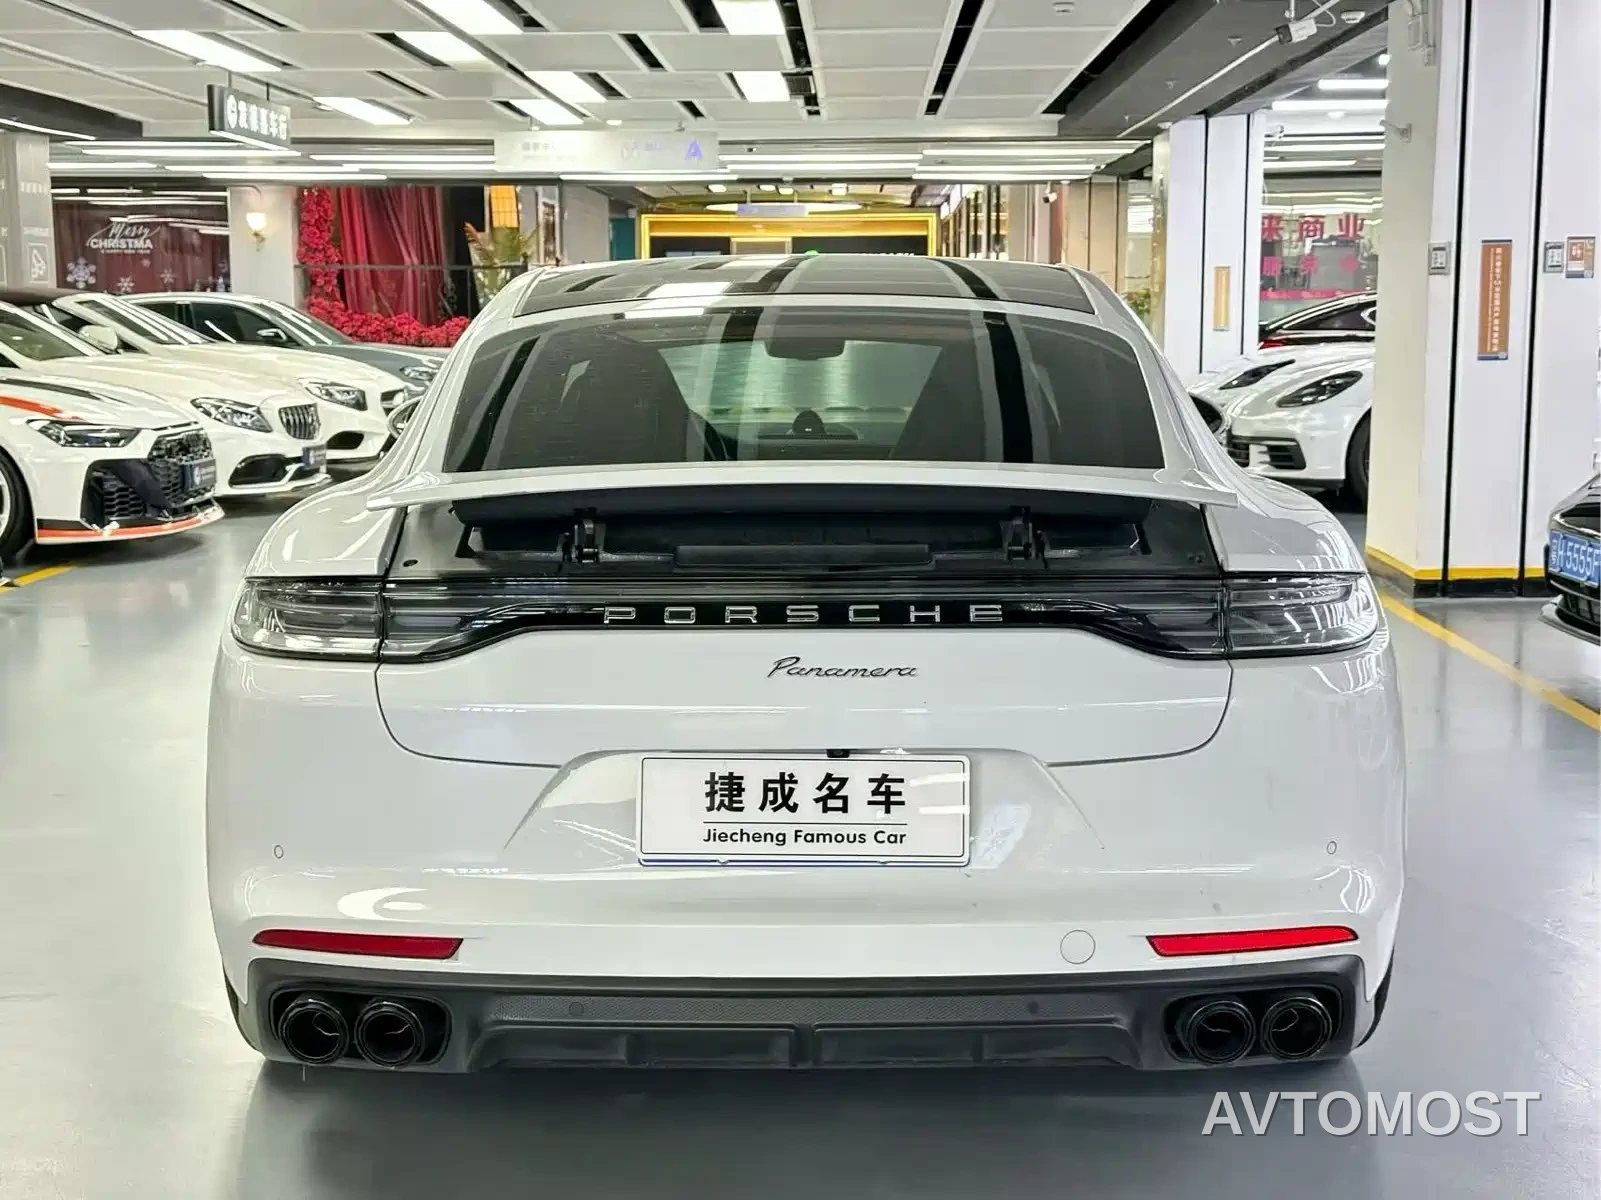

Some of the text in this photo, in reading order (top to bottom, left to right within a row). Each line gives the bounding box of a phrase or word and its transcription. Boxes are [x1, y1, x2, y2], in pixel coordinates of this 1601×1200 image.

[603, 604, 1003, 624] PORSCHE
[767, 656, 917, 678] Panamera
[704, 771, 906, 814] 捷成名车
[703, 828, 907, 847] Jiecheng Famous Car
